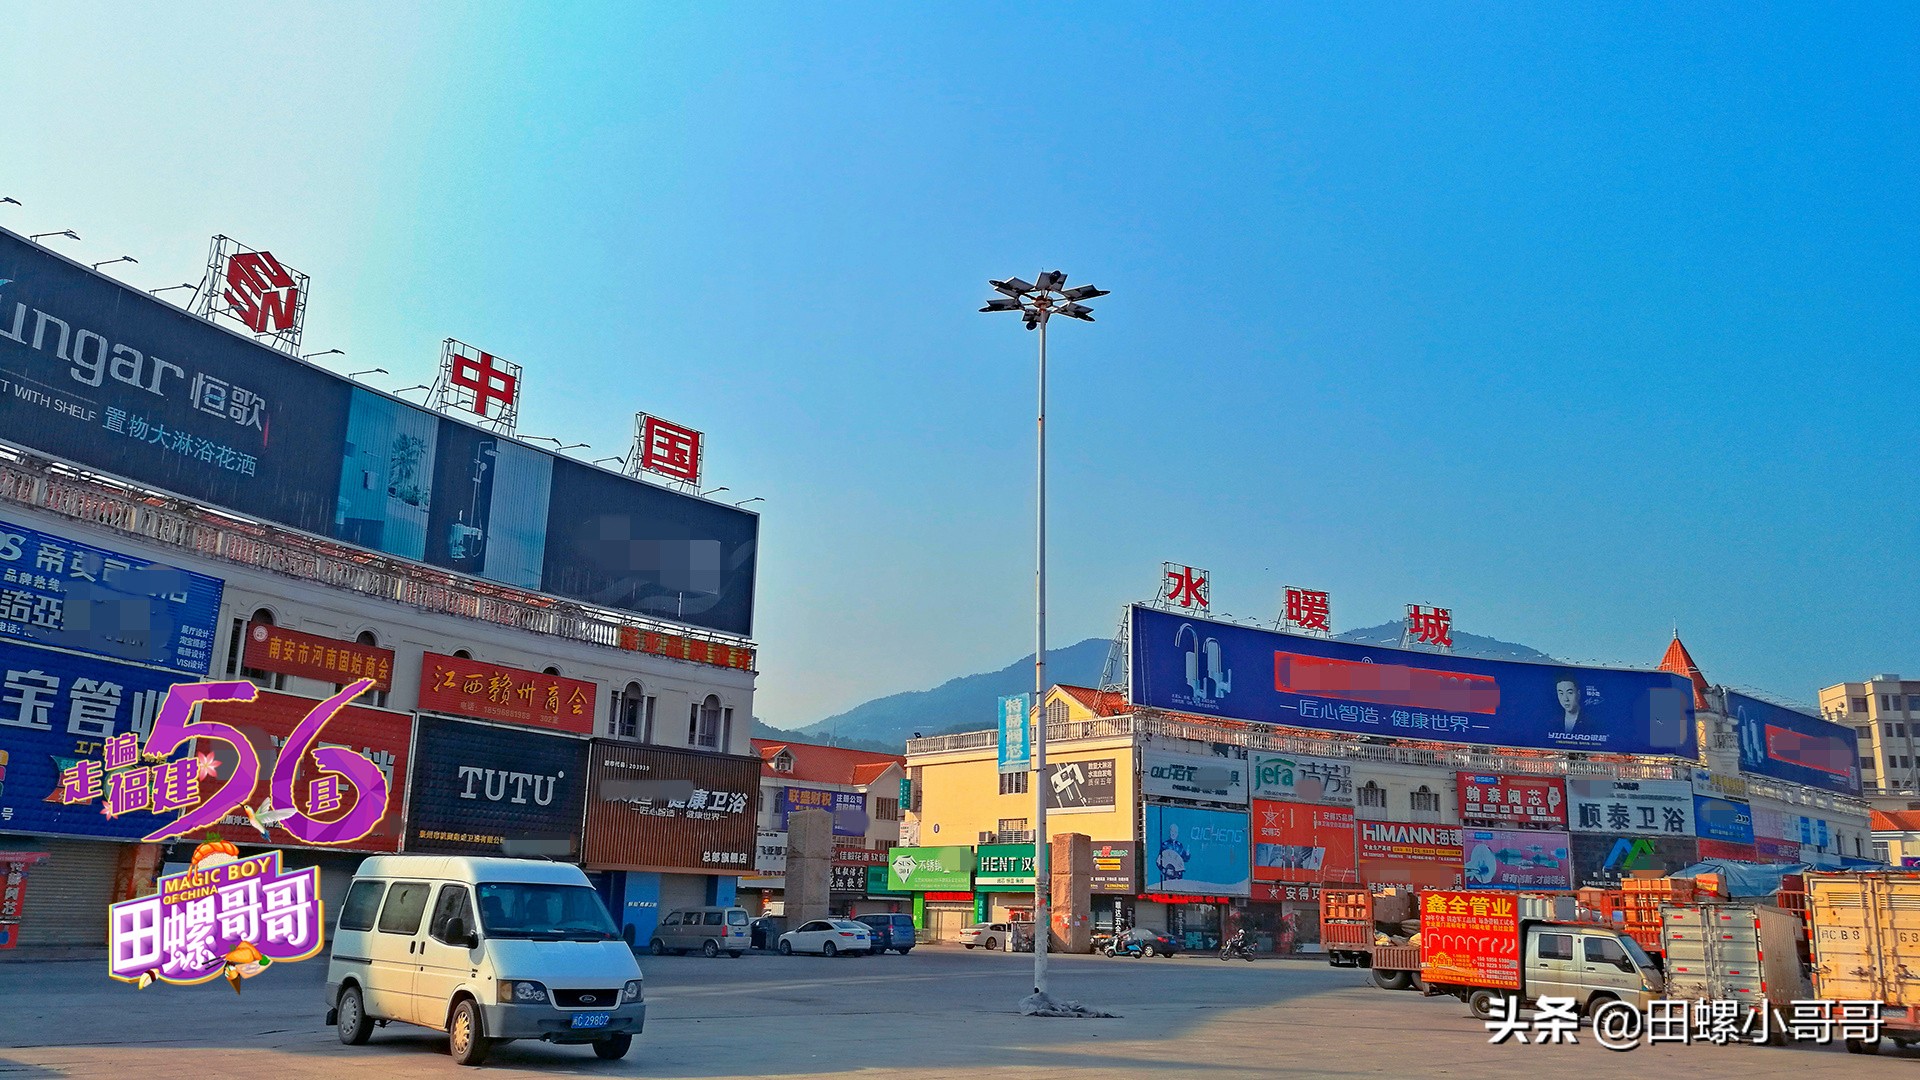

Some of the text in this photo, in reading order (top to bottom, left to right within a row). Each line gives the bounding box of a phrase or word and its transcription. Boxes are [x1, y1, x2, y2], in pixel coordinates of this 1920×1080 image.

[14, 383, 51, 409] WITH
[54, 398, 97, 421] SHELF
[190, 371, 267, 432] 恒歌
[451, 352, 700, 483] 中 国
[102, 405, 257, 478] 置物大淋浴花洒
[1167, 566, 1453, 647] 水 暖 城
[268, 635, 389, 680] 南安市河南固始商会
[433, 664, 588, 716] 江西赣州商会
[458, 765, 557, 806] TUTU
[1255, 755, 1295, 791] jefa
[1362, 823, 1435, 845] HIMANN
[1579, 802, 1685, 833] 顺泰卫浴
[702, 850, 748, 864] 总部旗舰店
[981, 856, 1016, 873] HENT
[1426, 893, 1513, 917] 鑫全管业
